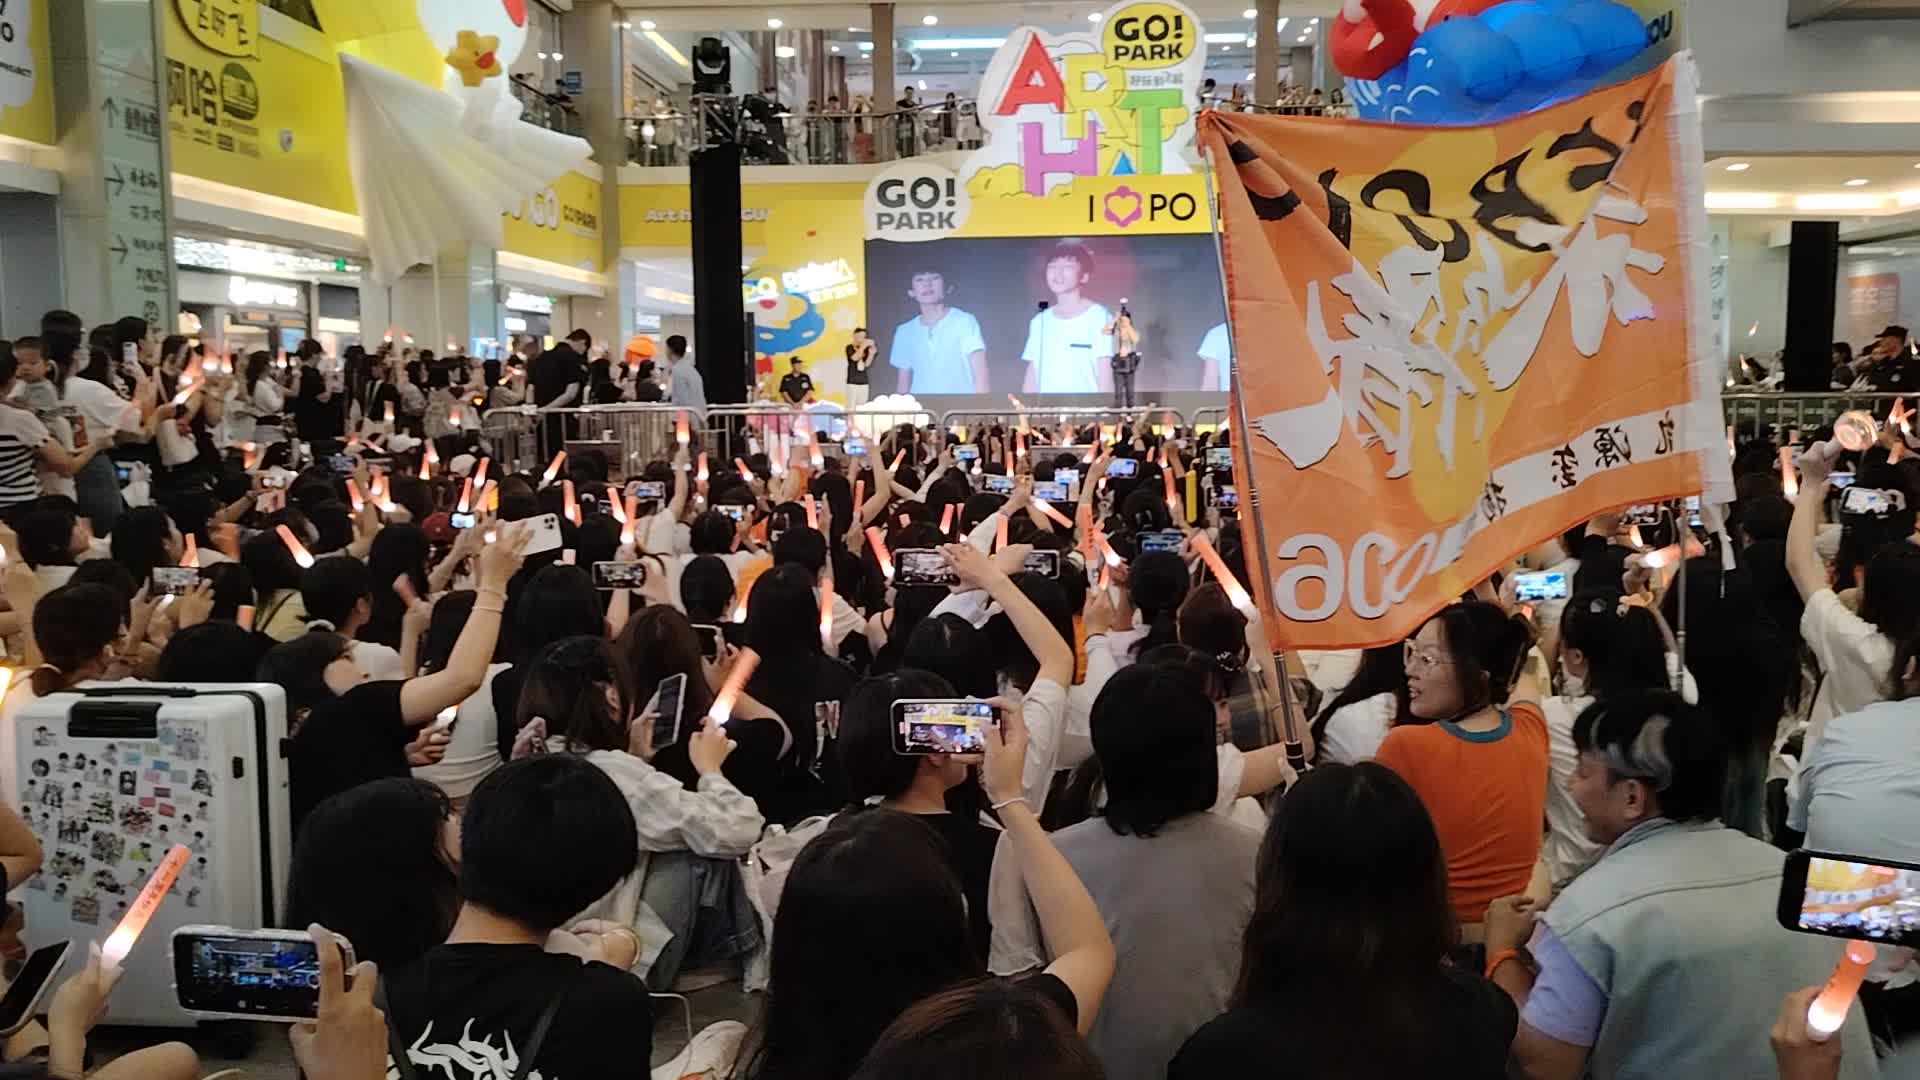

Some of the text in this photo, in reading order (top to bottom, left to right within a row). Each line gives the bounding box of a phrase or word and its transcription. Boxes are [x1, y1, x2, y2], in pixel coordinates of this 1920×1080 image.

[1114, 14, 1183, 42] GO!
[1113, 42, 1183, 61] PARK
[876, 176, 956, 209] GO!
[876, 211, 956, 231] PARK
